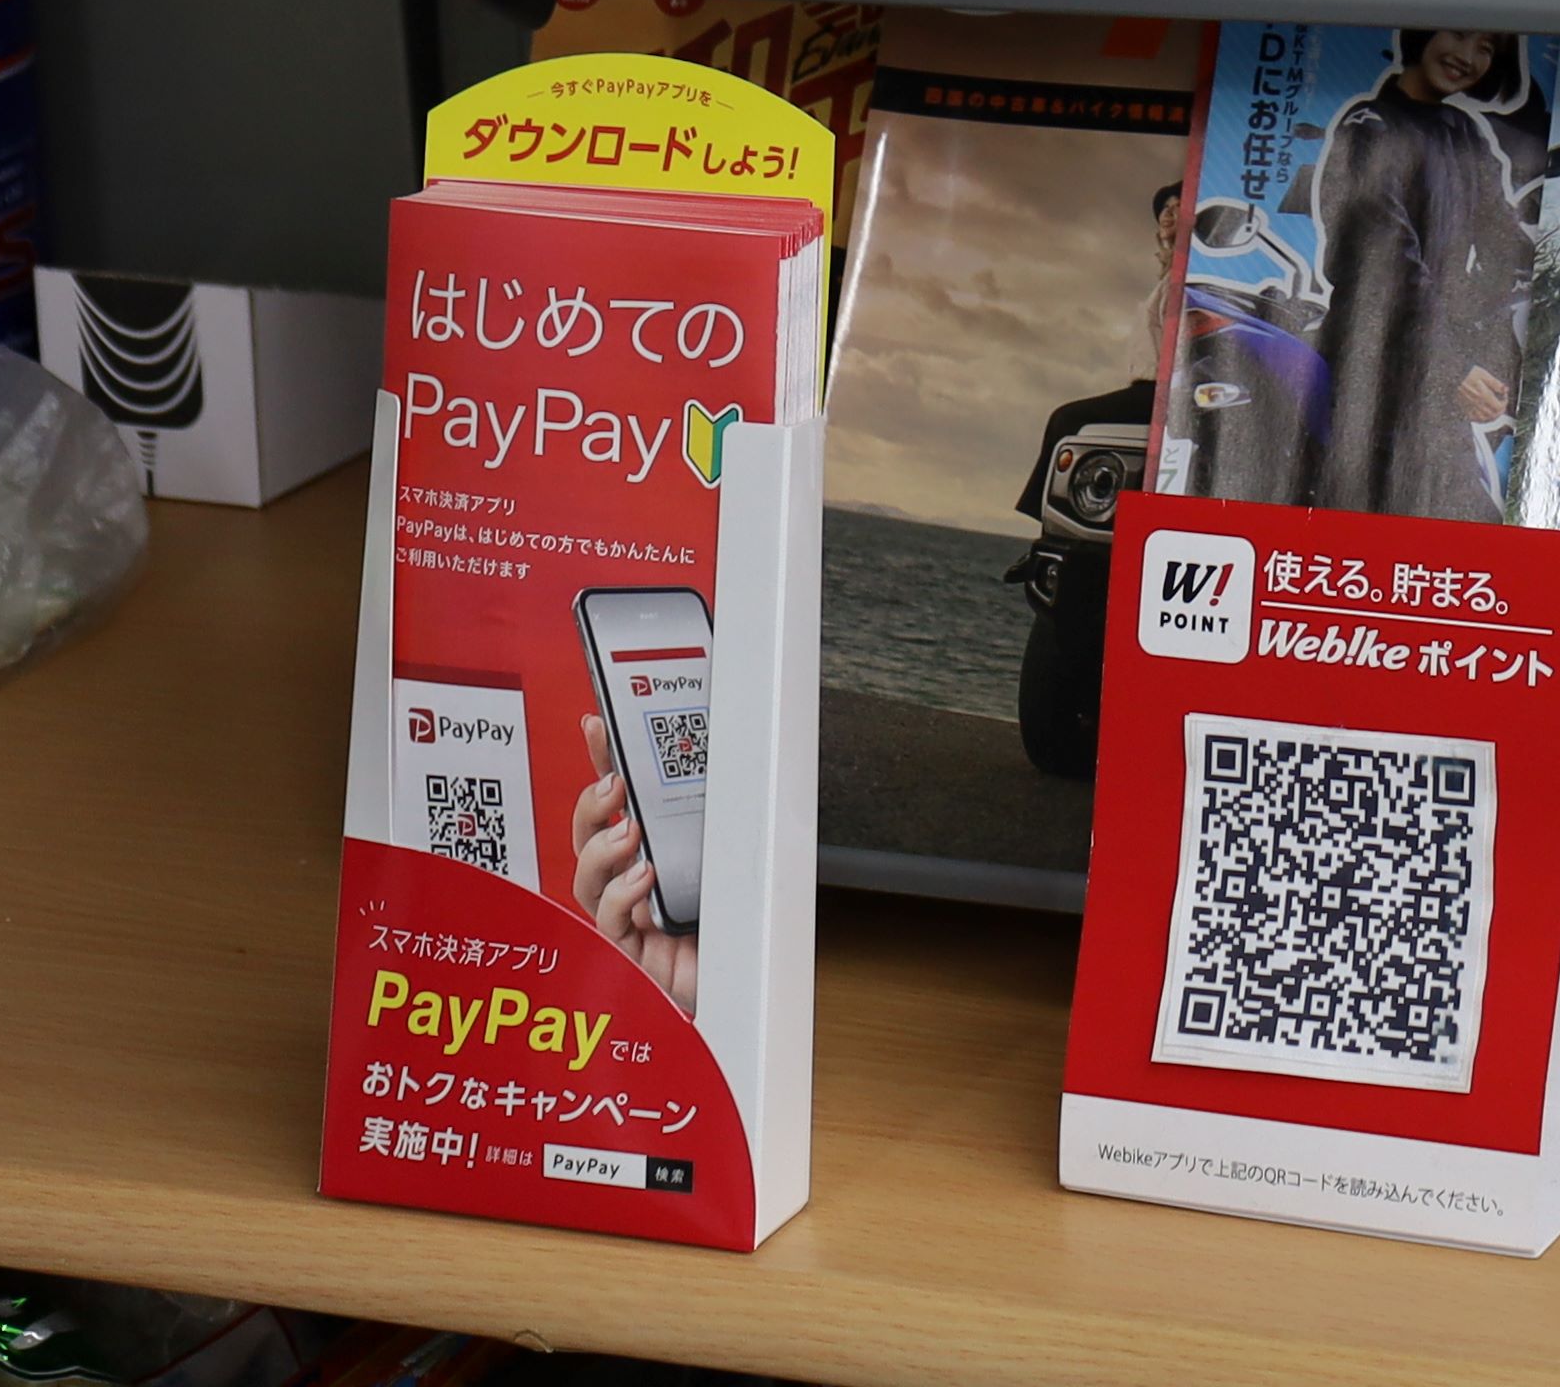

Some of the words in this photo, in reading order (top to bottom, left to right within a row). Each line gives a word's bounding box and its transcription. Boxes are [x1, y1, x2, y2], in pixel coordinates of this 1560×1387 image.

[550, 77, 713, 107] 今すぐPayPayアプリを
[463, 114, 799, 180] ダウンロードしよう!
[411, 269, 745, 368] はじめての
[404, 371, 672, 483] PayPay
[400, 486, 516, 515] スマホ決済アプリ
[396, 515, 695, 564] PayPayは、はじめての方でもかんたんに
[396, 547, 530, 579] ご利用いただけます
[1263, 549, 1509, 616] 使える。貯まる。
[1159, 611, 1229, 635] POINT
[652, 674, 703, 693] PayPay
[1418, 641, 1554, 688] ポイント
[440, 716, 515, 746] PayPay
[369, 924, 559, 975] スマホ決済アプリ
[362, 1062, 698, 1134] おトクなキャンペーン
[359, 1116, 478, 1169] 実施中!
[553, 1154, 621, 1179] PayPay
[655, 1166, 684, 1184] 検索
[1098, 1143, 1506, 1218] Webikeアプリで上記のQRコードを読み込んでください。
